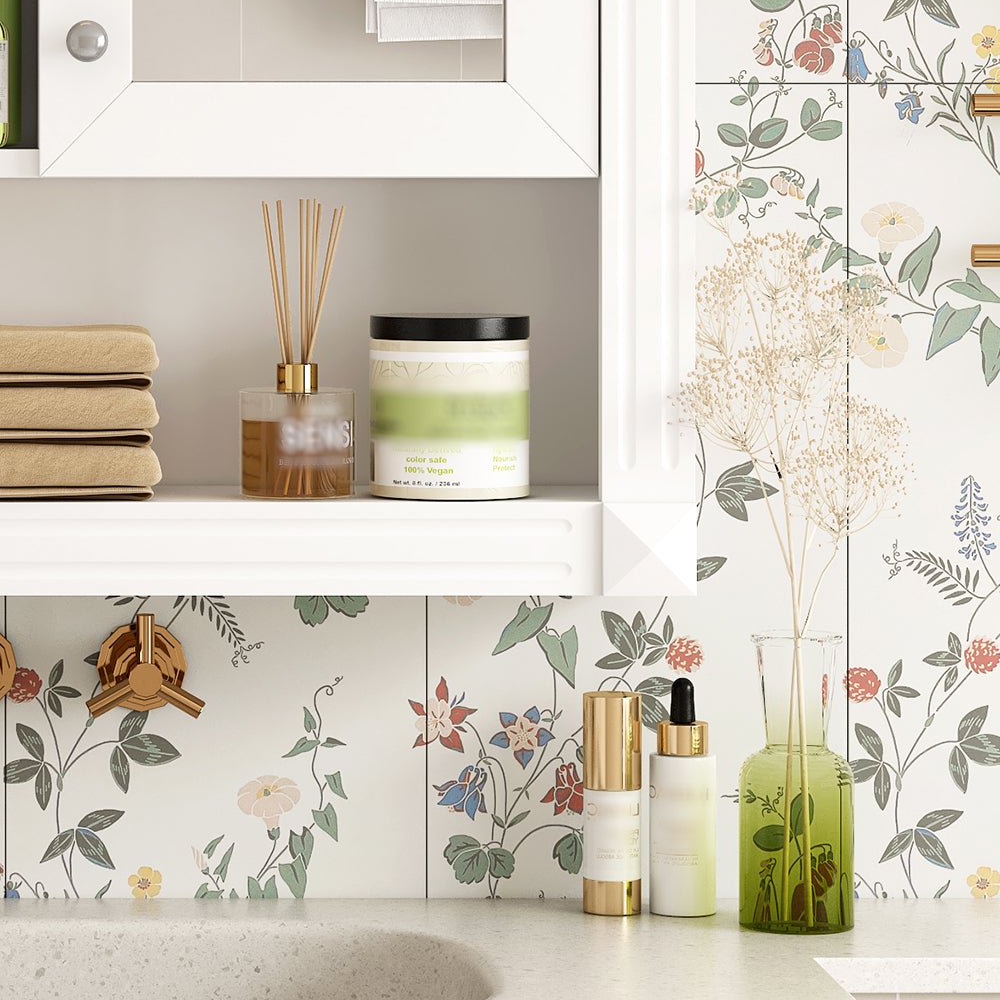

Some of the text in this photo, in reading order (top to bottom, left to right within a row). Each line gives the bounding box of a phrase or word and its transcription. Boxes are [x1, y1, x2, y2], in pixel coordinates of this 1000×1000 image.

[428, 456, 447, 464] safe
[404, 466, 454, 476] 100% Vegan
